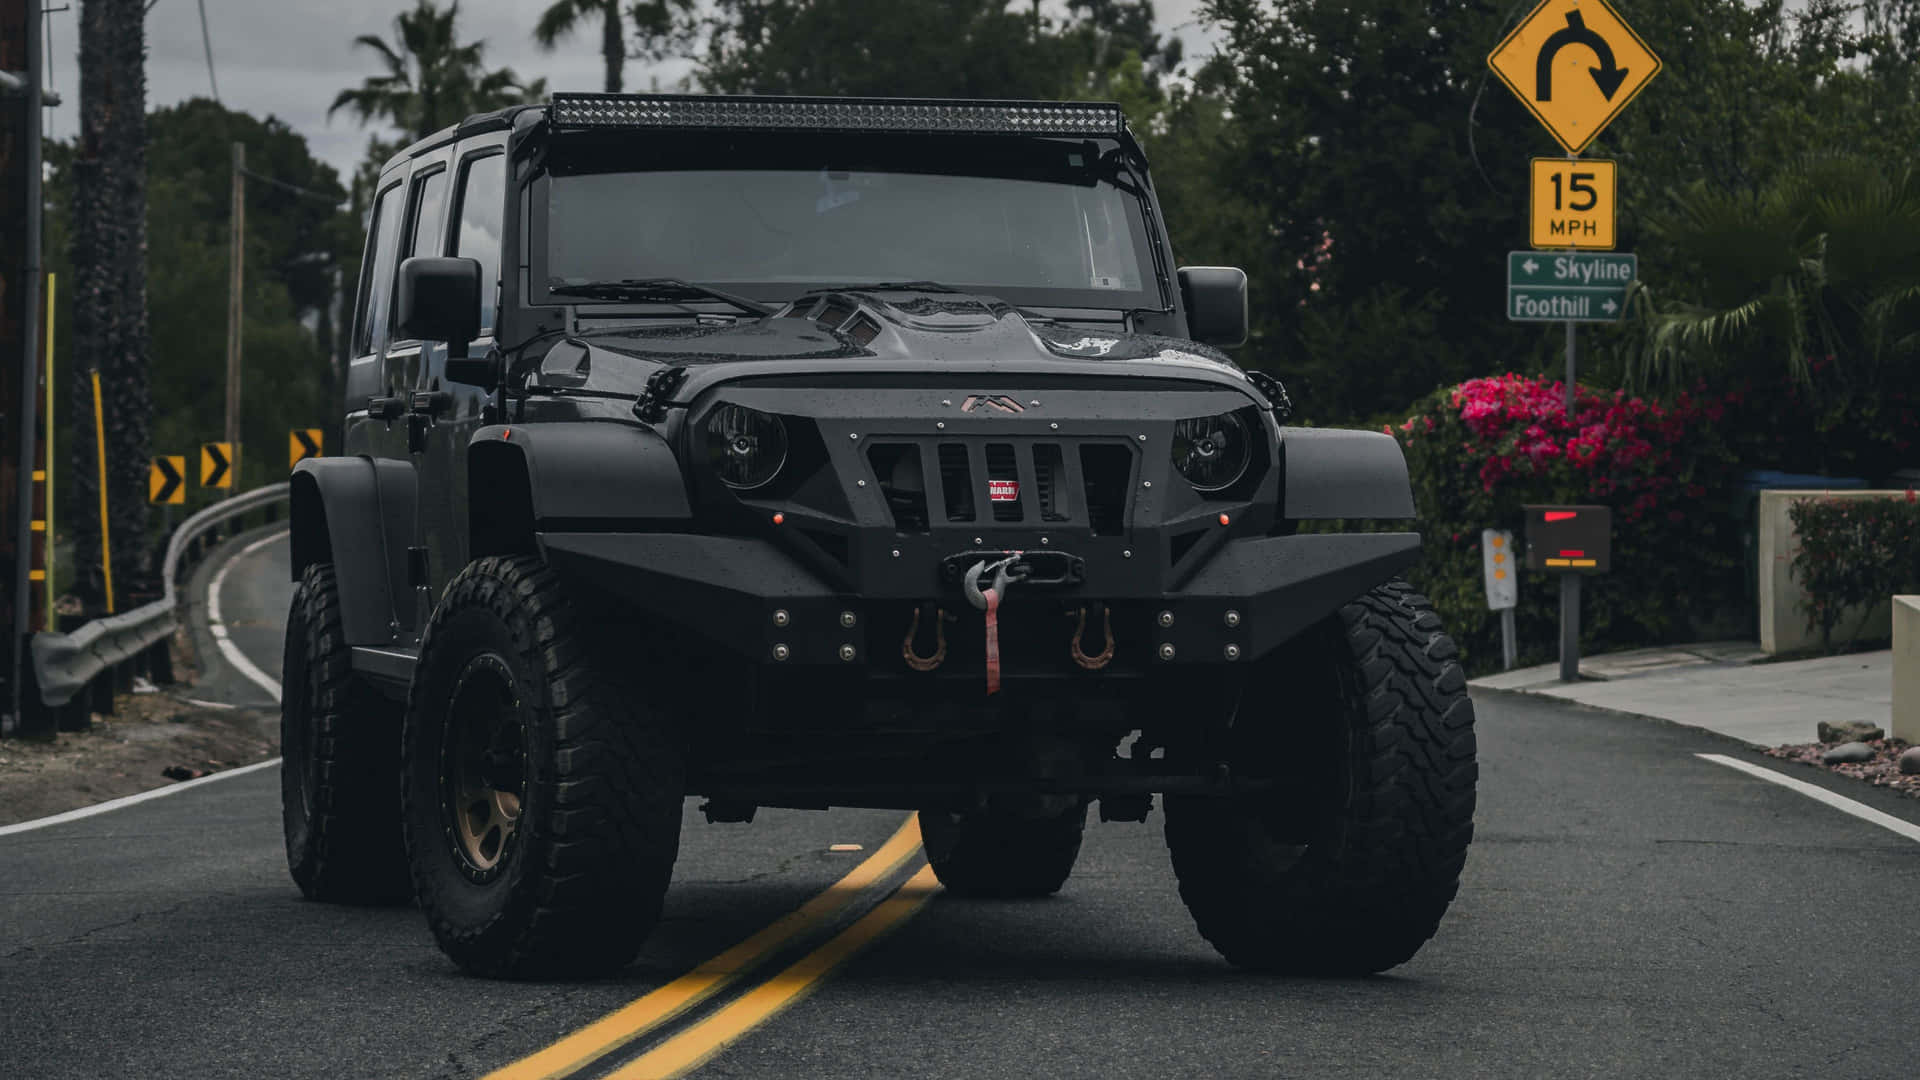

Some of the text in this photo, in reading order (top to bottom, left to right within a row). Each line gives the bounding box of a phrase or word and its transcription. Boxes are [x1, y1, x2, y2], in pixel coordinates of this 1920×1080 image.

[1550, 172, 1598, 212] 15
[1550, 220, 1597, 236] MPH
[1554, 257, 1631, 284] Skyline
[1515, 294, 1590, 317] Foothill
